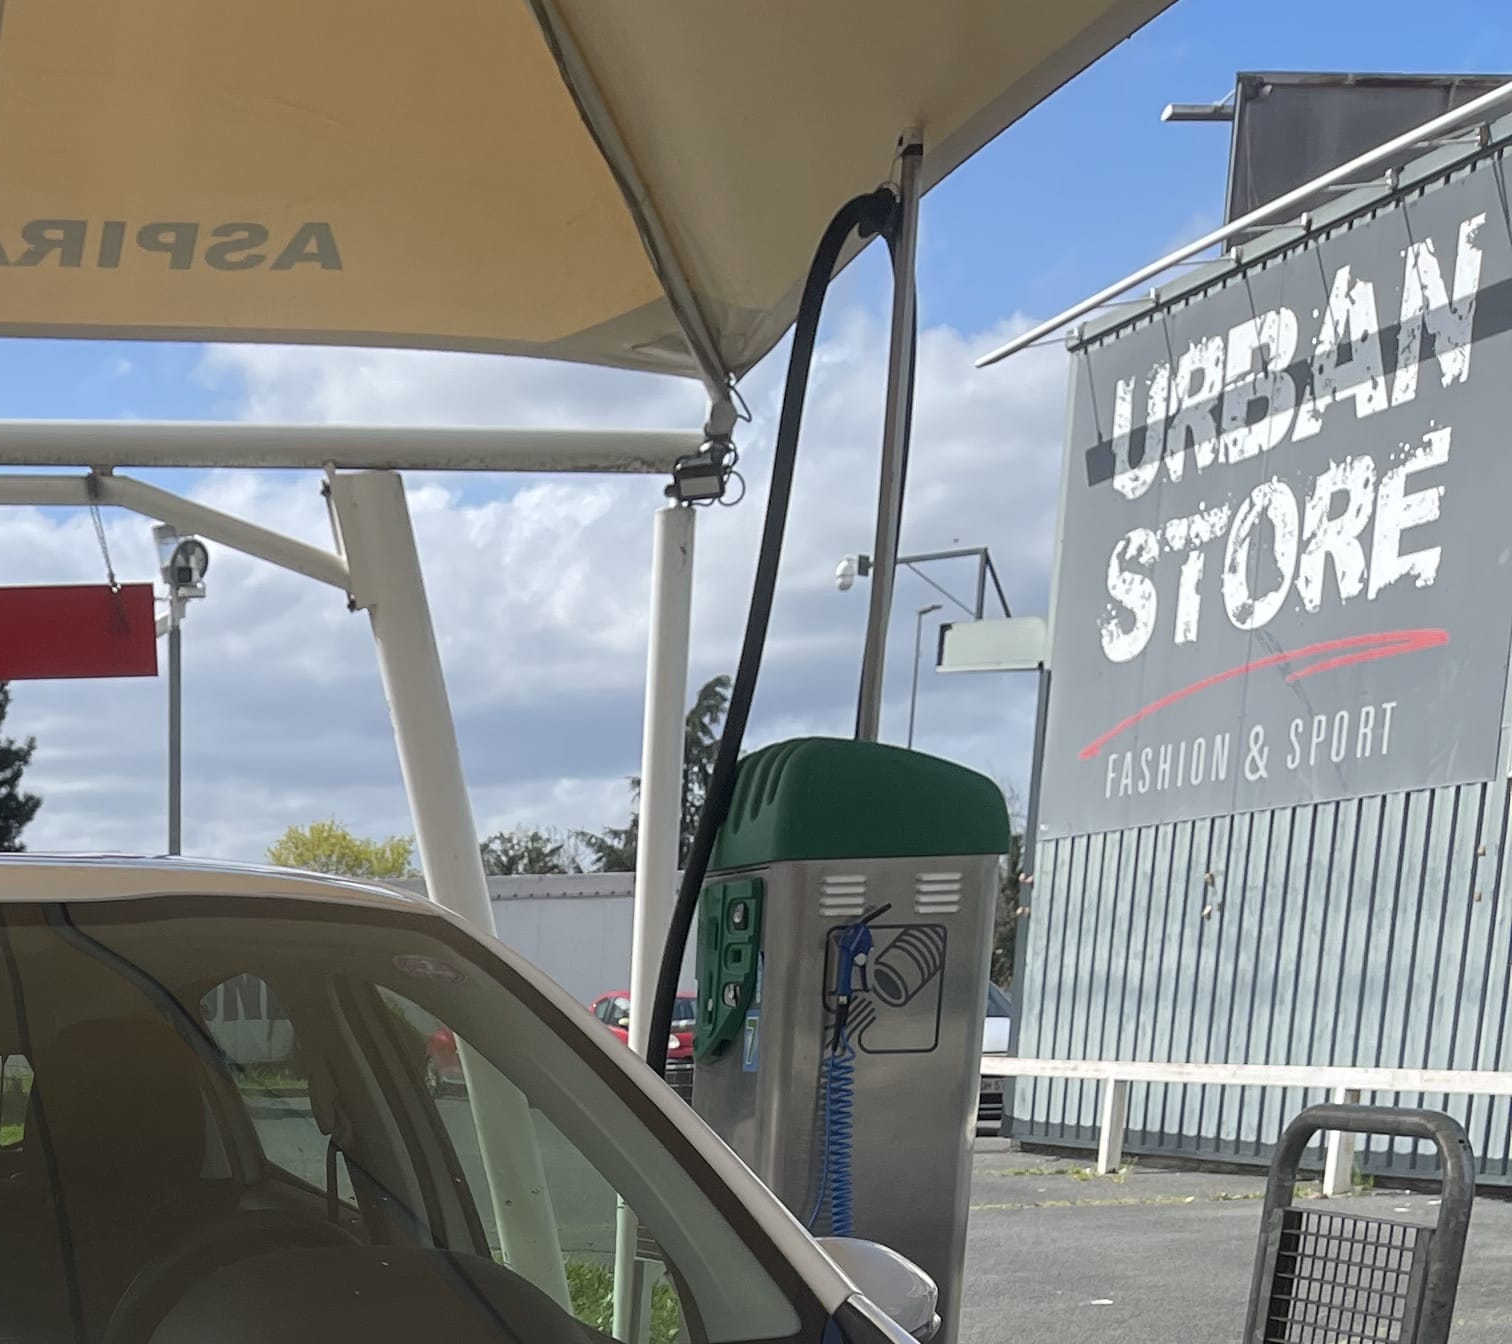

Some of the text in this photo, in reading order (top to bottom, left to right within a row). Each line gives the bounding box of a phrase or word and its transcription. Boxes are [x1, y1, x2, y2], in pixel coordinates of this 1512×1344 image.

[1110, 211, 1487, 500] URBAN
[1098, 421, 1453, 663] STORE
[1104, 701, 1397, 798] FASHION & SPORT
[746, 1017, 759, 1065] 7
